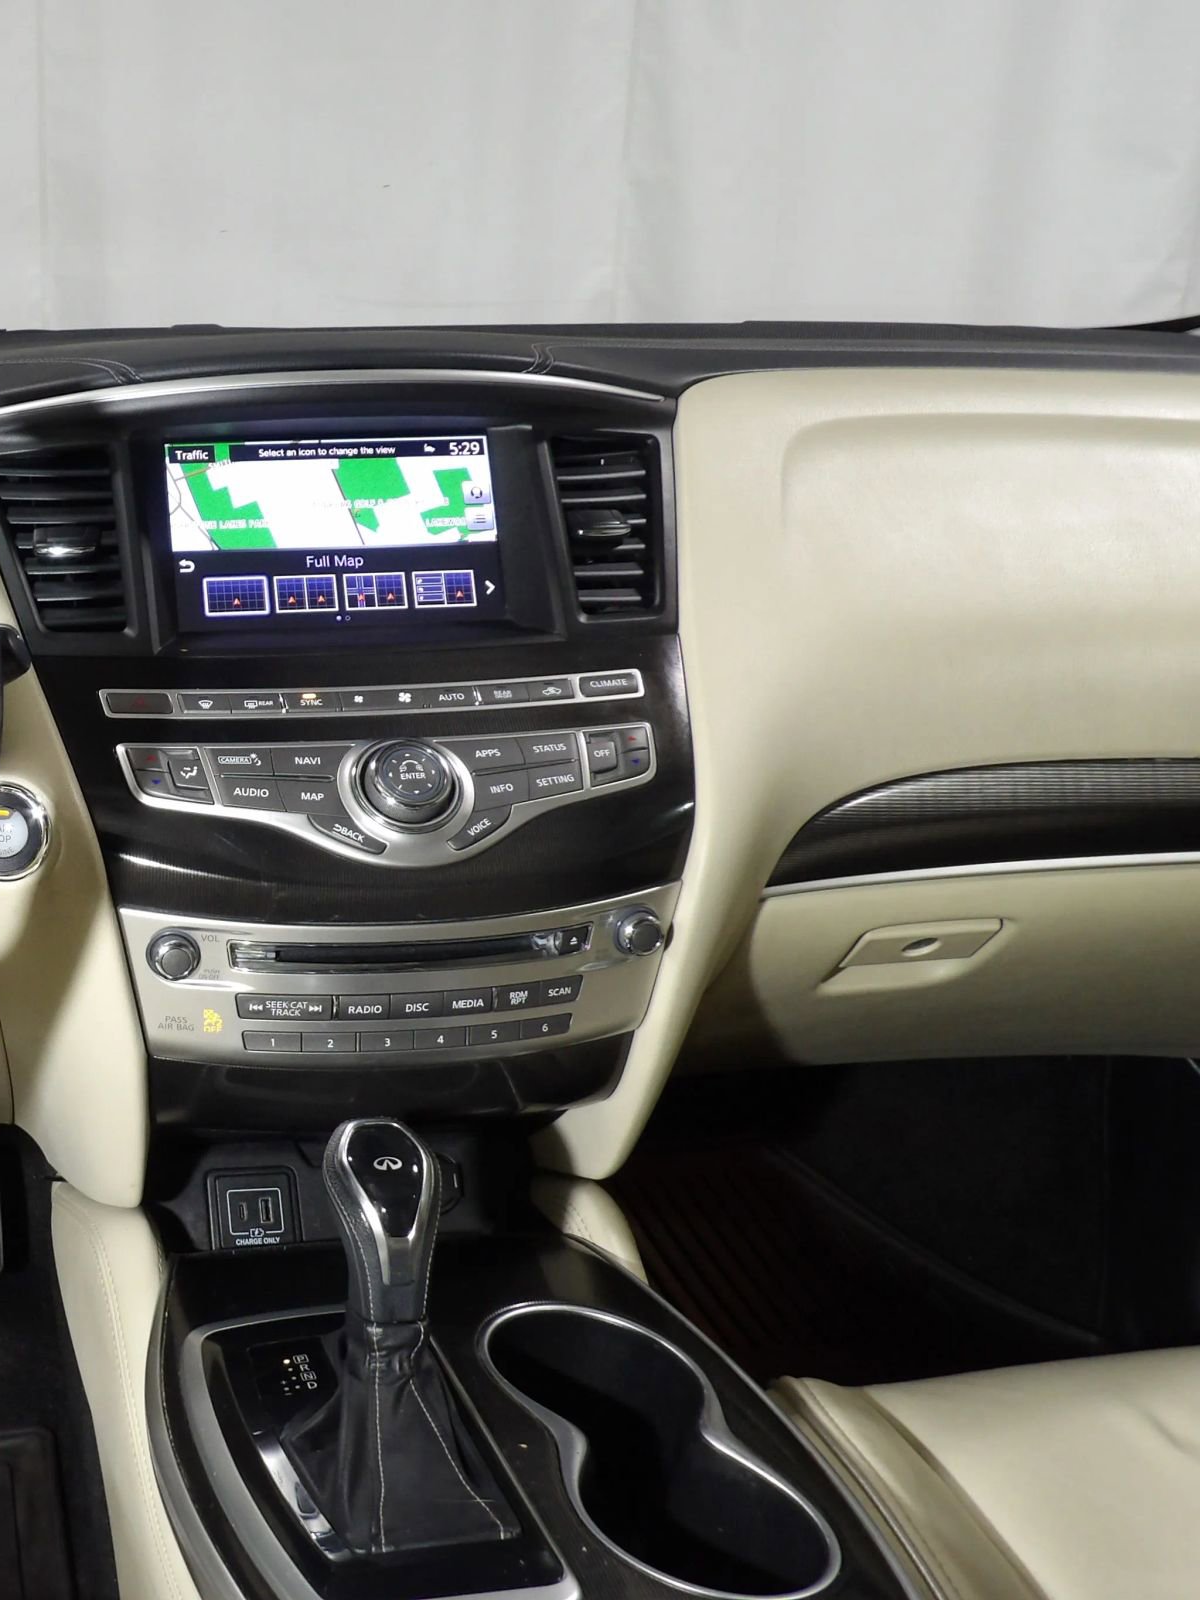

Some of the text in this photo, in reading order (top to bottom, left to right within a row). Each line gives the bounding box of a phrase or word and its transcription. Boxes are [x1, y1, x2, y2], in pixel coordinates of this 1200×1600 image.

[258, 448, 284, 457] Select
[298, 447, 316, 456] icon
[317, 448, 327, 456] to
[328, 447, 358, 458] change
[360, 446, 374, 455] the
[375, 446, 396, 455] view
[449, 442, 480, 456] 5:29
[175, 449, 209, 460] Traffic
[306, 555, 364, 570] Full Map
[589, 678, 628, 688] CLIMATE
[439, 692, 465, 701] AUTO
[300, 698, 323, 706] SYNC
[532, 743, 567, 753] STATUS
[475, 748, 501, 758] APPS
[593, 749, 610, 758] OFF
[219, 756, 250, 764] CAMERA
[294, 756, 321, 765] NAVI
[400, 772, 426, 780] ENTER
[536, 774, 575, 787] SETTING
[233, 787, 269, 798] AUDIO
[489, 783, 514, 794] INFO
[301, 792, 325, 801] MAP
[467, 818, 491, 837] VOICE
[340, 826, 365, 843] BACK
[201, 934, 218, 942] VOL
[509, 990, 528, 999] RDM
[548, 986, 571, 997] SCAN
[452, 998, 484, 1008] MEDIA
[510, 997, 527, 1005] RPT
[348, 1005, 382, 1014] RADIO
[405, 1002, 429, 1012] DISC
[271, 1008, 301, 1017] TRACK
[165, 1015, 188, 1024] PASS
[158, 1022, 195, 1031] AIR BAG
[542, 1023, 548, 1032] 6
[491, 1030, 497, 1039] 5
[327, 1039, 334, 1048] 2
[384, 1038, 391, 1047] 3
[437, 1035, 444, 1044] 4
[236, 1236, 280, 1246] CHARGE ONLY
[297, 1354, 305, 1363] P
[304, 1372, 313, 1380] N
[307, 1381, 318, 1389] D
